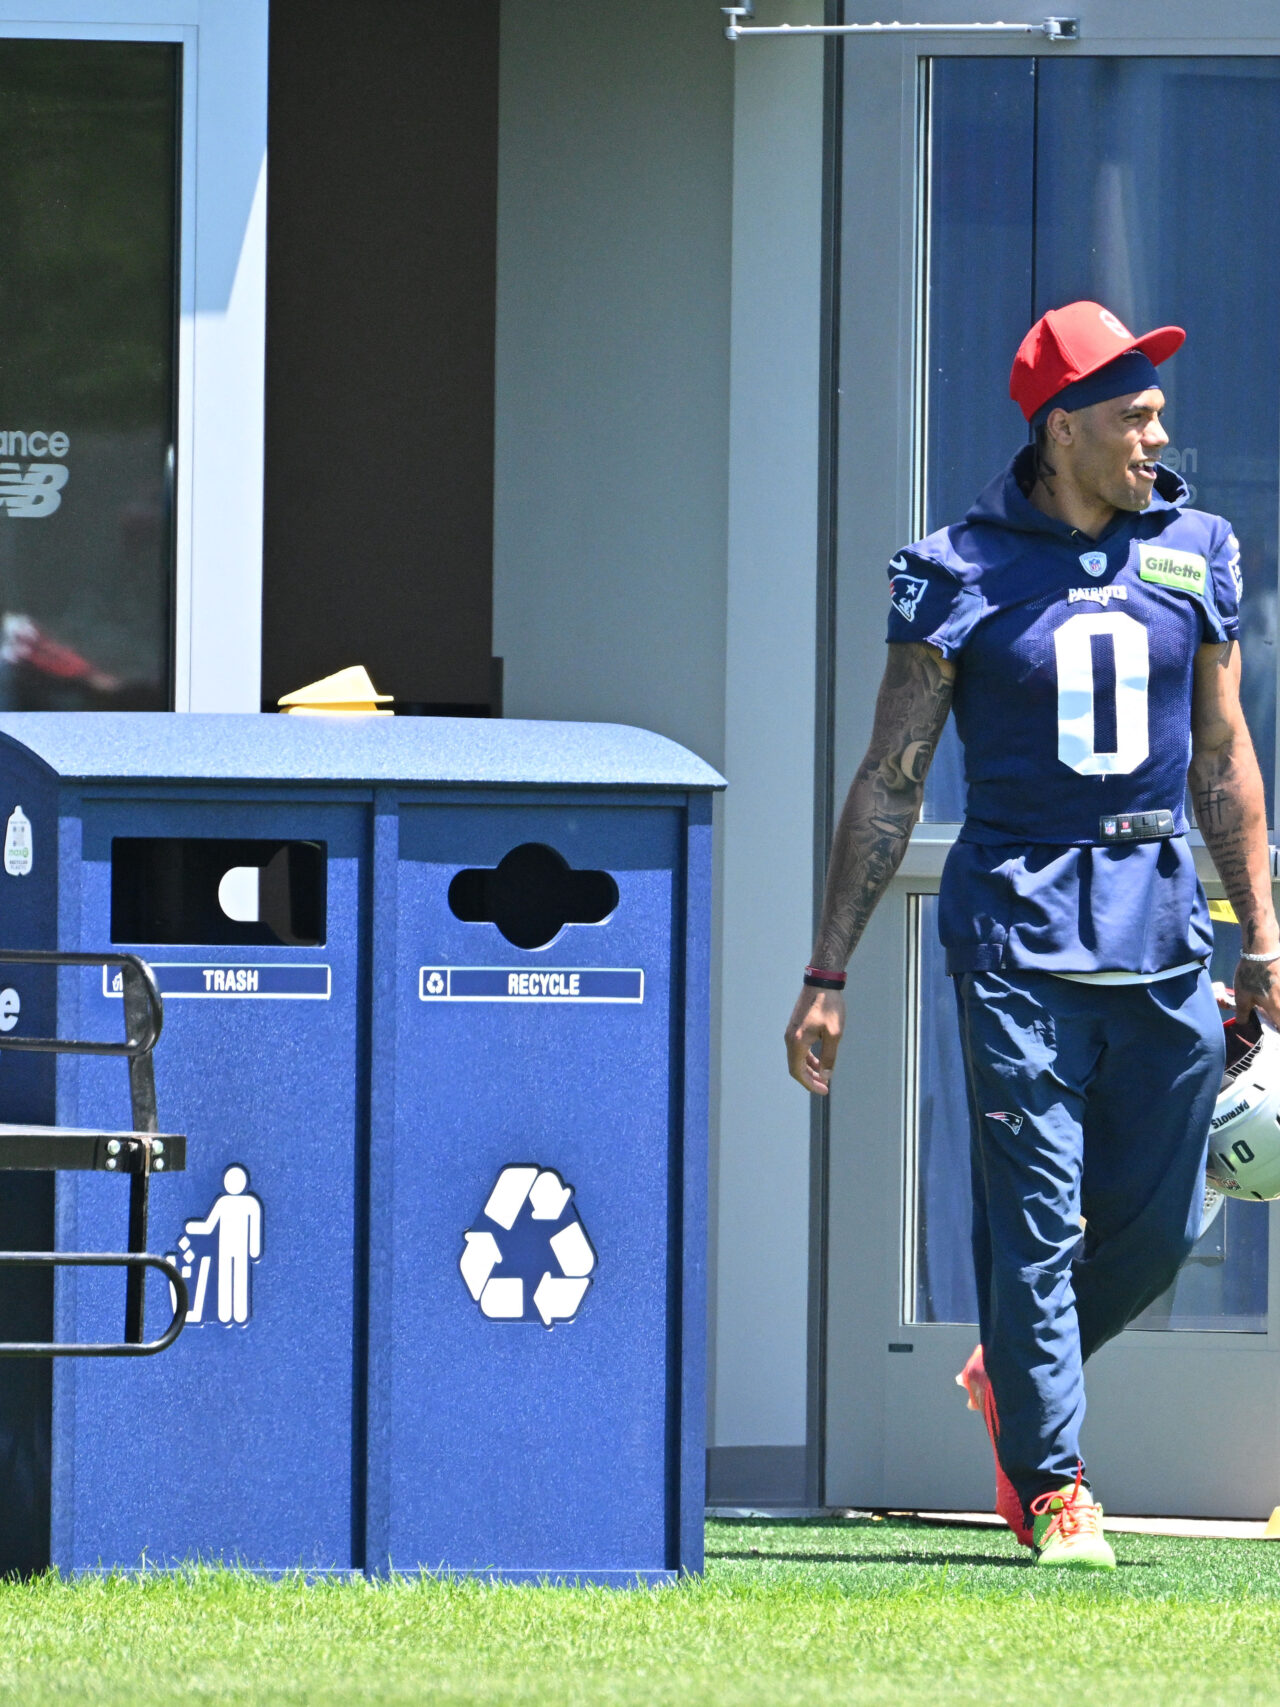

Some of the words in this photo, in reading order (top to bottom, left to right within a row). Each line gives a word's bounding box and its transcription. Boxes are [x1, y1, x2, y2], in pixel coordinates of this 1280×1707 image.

[1145, 556, 1202, 582] Gillette
[1053, 611, 1150, 776] 0
[203, 970, 259, 992] TRASH
[507, 973, 580, 996] RECYCLE
[1211, 1099, 1250, 1130] PATRIOTS
[1232, 1140, 1255, 1164] 0
